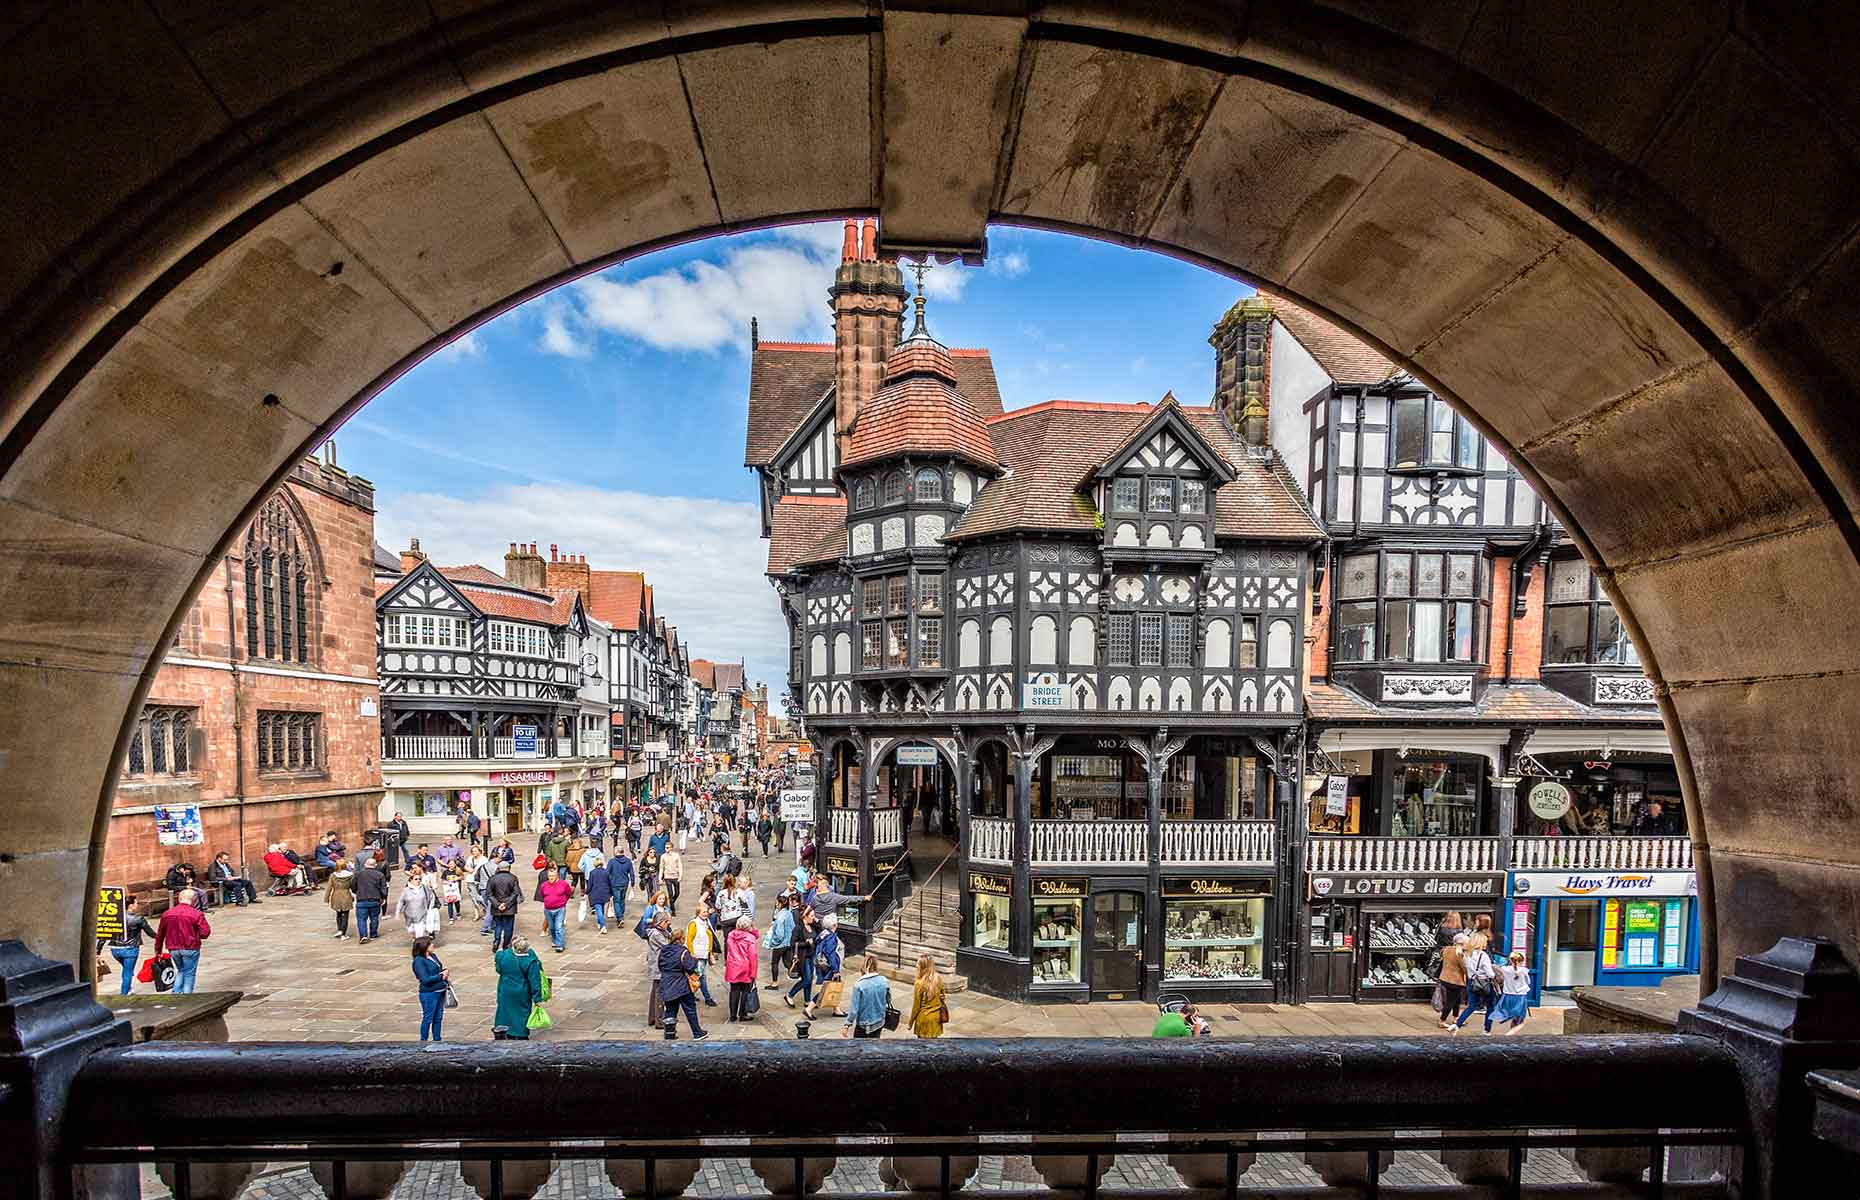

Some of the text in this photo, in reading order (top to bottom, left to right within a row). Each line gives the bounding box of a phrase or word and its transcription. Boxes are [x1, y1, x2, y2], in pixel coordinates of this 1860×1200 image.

[1032, 687, 1062, 696] BRIDGE
[1031, 697, 1063, 706] STREET
[1329, 780, 1346, 791] Gabor
[783, 793, 811, 803] Gabor
[974, 876, 1007, 892] Waltons
[1040, 881, 1080, 894] Waltons
[1190, 880, 1233, 894] Waltons
[1343, 879, 1493, 894] LOTUS diamond
[1566, 875, 1654, 891] Hays Travel
